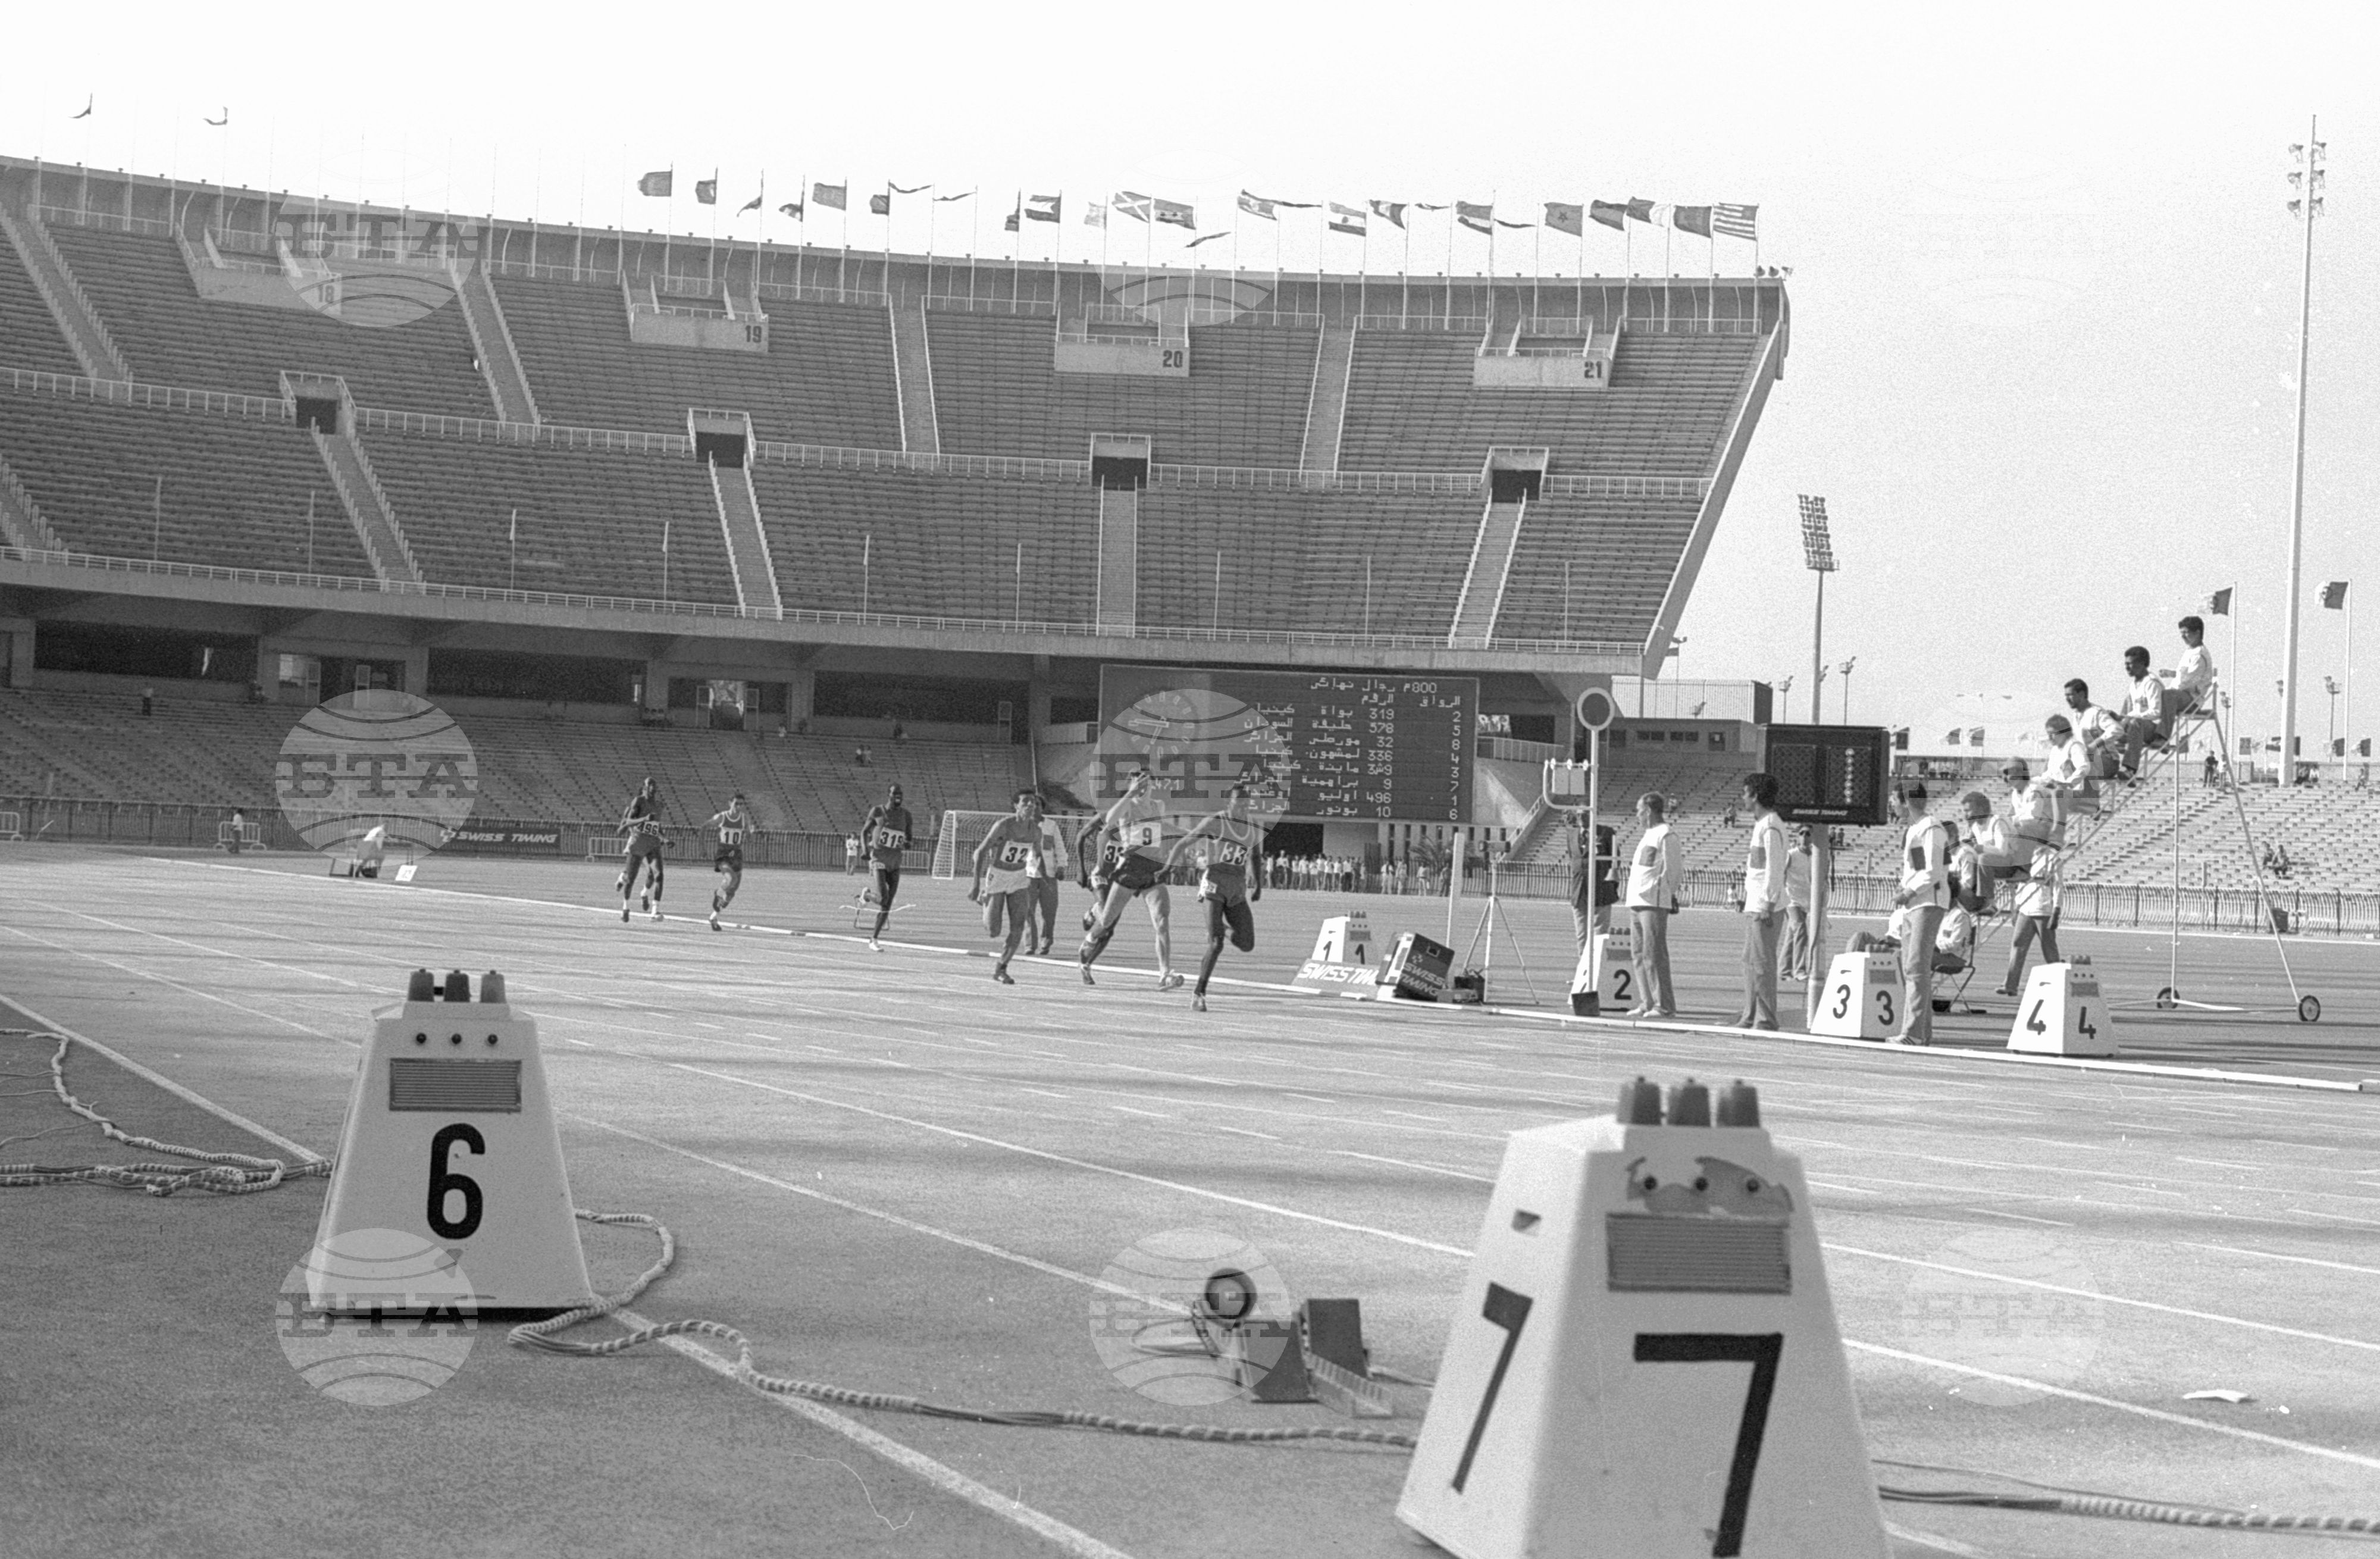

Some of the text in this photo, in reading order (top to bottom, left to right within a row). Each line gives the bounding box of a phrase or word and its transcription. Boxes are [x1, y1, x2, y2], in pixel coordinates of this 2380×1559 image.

[318, 285, 334, 302] 18
[746, 325, 762, 343] 19
[1163, 350, 1183, 368] 20
[1584, 361, 1602, 378] 21
[1257, 703, 1295, 716] كينيا
[1369, 708, 1394, 720] 319
[1452, 711, 1461, 722] 2
[1369, 722, 1394, 733] 578
[1452, 725, 1461, 736] 5
[1376, 737, 1394, 748] 32
[1452, 739, 1461, 750] 8
[1256, 744, 1293, 757] كينيا
[1368, 750, 1393, 761] 336
[1451, 753, 1459, 763] 4
[1451, 766, 1460, 778] 3
[1383, 778, 1392, 790] 9
[1450, 781, 1459, 792] 7
[1366, 791, 1392, 803] 496
[1452, 795, 1457, 806] 1
[1376, 806, 1391, 818] 10
[1449, 809, 1458, 820] 6
[457, 832, 558, 843] SWISS TIMING
[724, 831, 740, 844] 10
[1142, 828, 1153, 845] 9
[1006, 847, 1028, 863] 32
[1323, 941, 1332, 961] 1
[1355, 944, 1365, 965] 1
[1297, 963, 1354, 982] SWISS
[1403, 962, 1445, 987] SWISS
[1614, 969, 1631, 1000] 2
[1833, 984, 1851, 1019] 3
[1876, 990, 1894, 1026] 3
[2027, 999, 2047, 1035] 4
[2078, 1006, 2096, 1040] 4
[427, 1123, 486, 1240] 6
[1452, 1281, 1533, 1495] 7
[1633, 1332, 1784, 1558] 7
